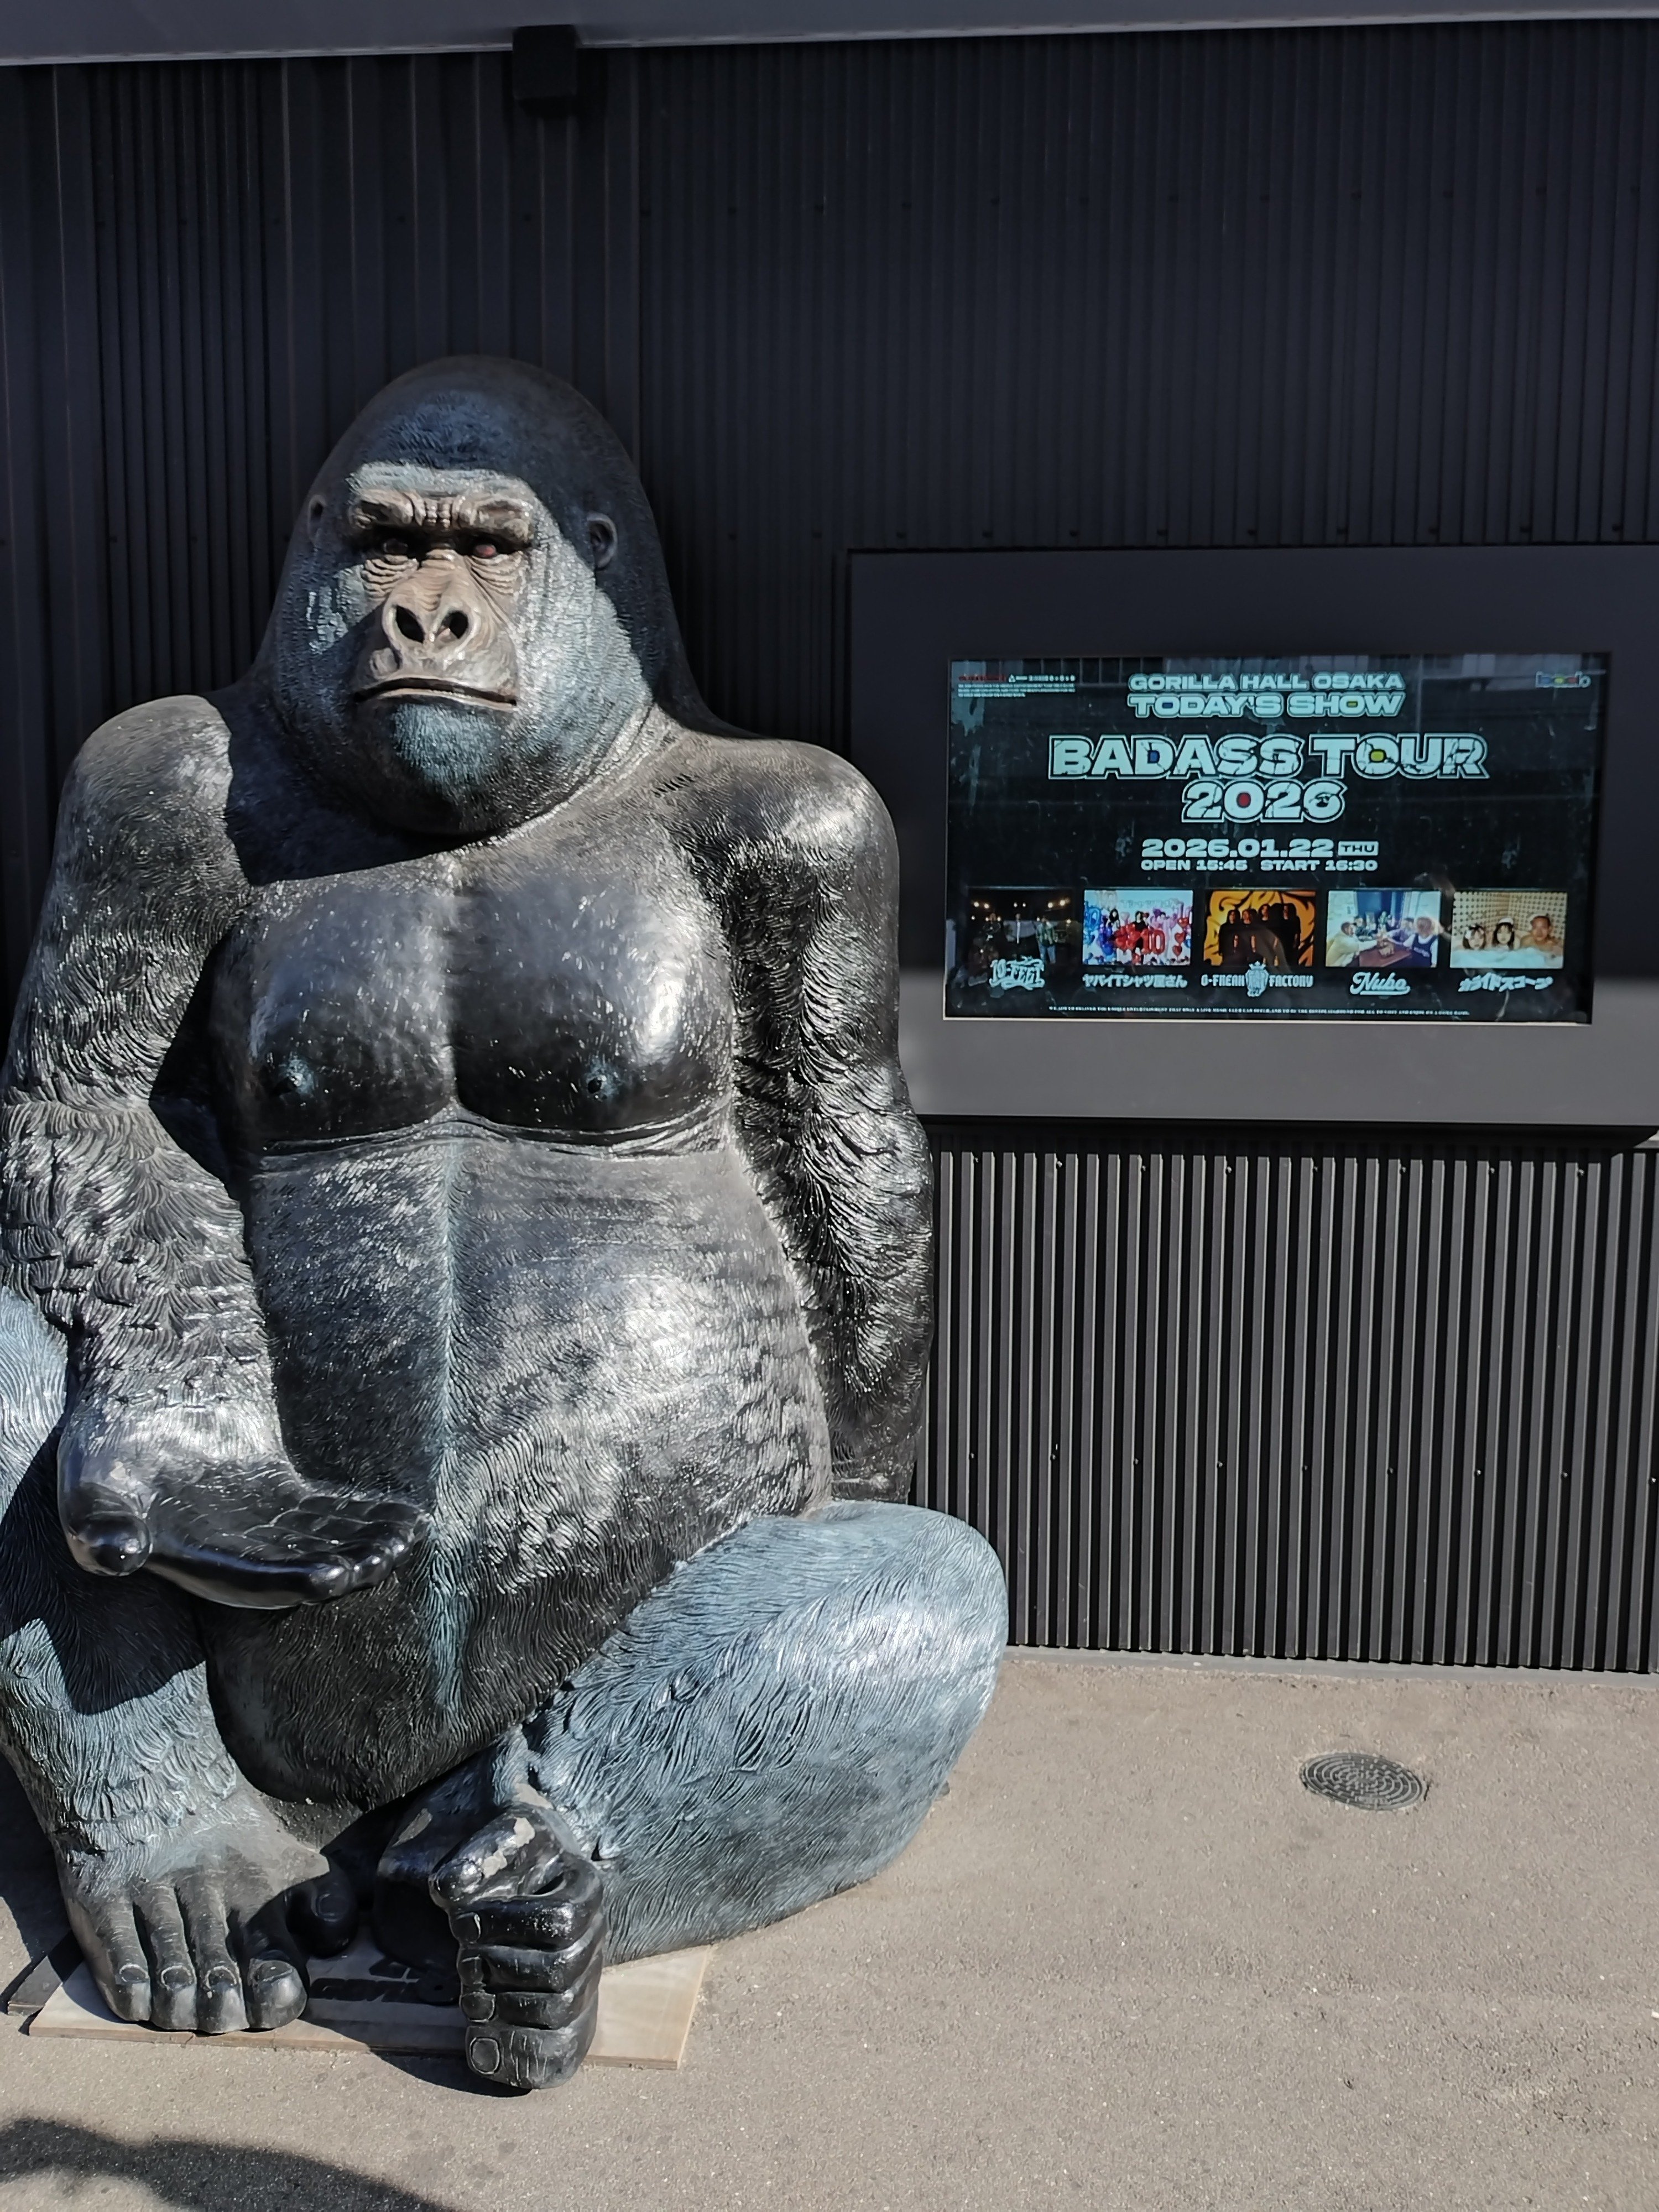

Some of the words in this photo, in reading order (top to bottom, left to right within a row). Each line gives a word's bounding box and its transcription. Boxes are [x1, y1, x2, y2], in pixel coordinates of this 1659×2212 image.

[1128, 673, 1238, 691] GORILLA
[1240, 672, 1310, 690] HALL
[1312, 671, 1406, 690] OSAKA
[1128, 692, 1283, 718] TODAY'S
[1286, 691, 1406, 717] SHOW
[1048, 734, 1306, 780] BADASS
[1309, 734, 1490, 780] TOUR
[1181, 778, 1347, 823] 2026
[1142, 838, 1334, 858] 2026.01.22
[1340, 843, 1376, 854] THU
[1141, 859, 1191, 870] OPEN
[1196, 859, 1248, 871] 15:45
[1260, 860, 1320, 871] START
[1326, 860, 1378, 872] 16:30
[989, 957, 1045, 990] 10-FEET
[1269, 974, 1313, 987] FACTORY
[1349, 972, 1411, 995] Nubo
